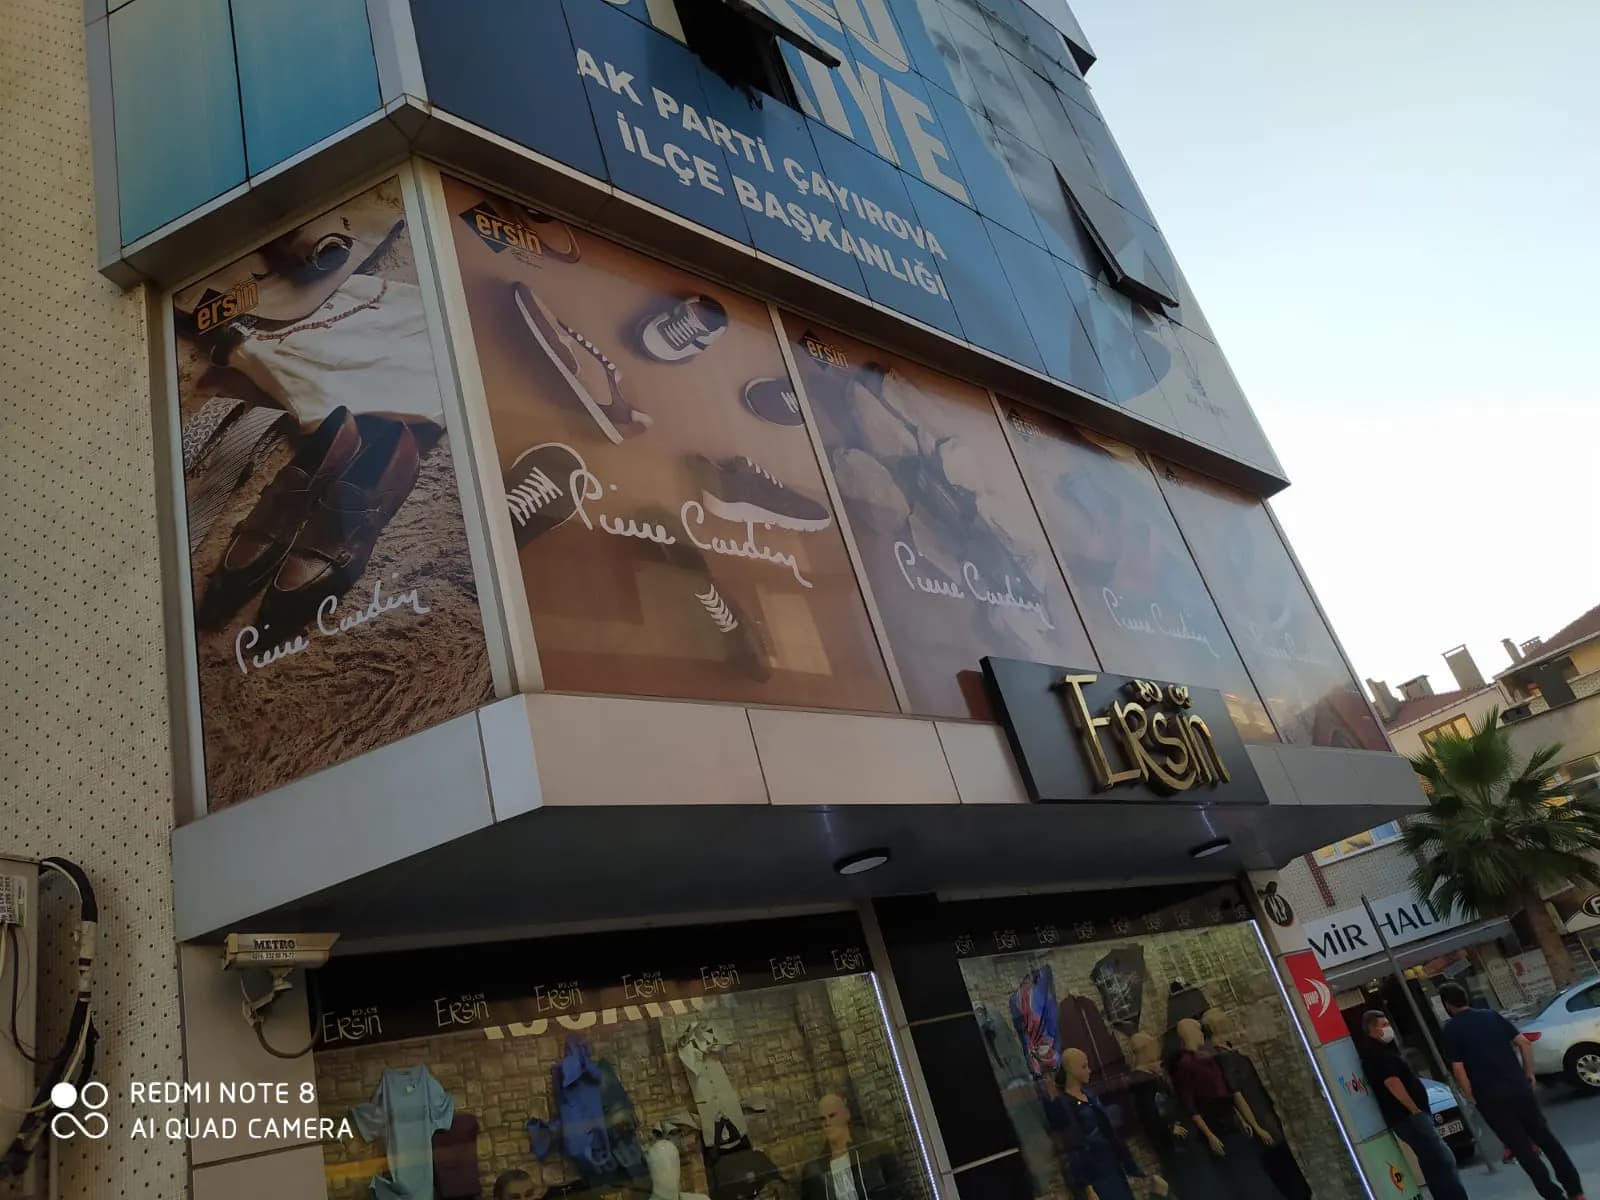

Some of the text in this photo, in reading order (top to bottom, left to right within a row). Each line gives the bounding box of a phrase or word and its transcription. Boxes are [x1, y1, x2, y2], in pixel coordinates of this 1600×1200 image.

[576, 48, 948, 261] AK PARTİ ÇAYIROVA
[616, 110, 949, 301] İLÇE BAŞKANLIĞI
[475, 214, 543, 256] ersin
[254, 939, 296, 950] METRO
